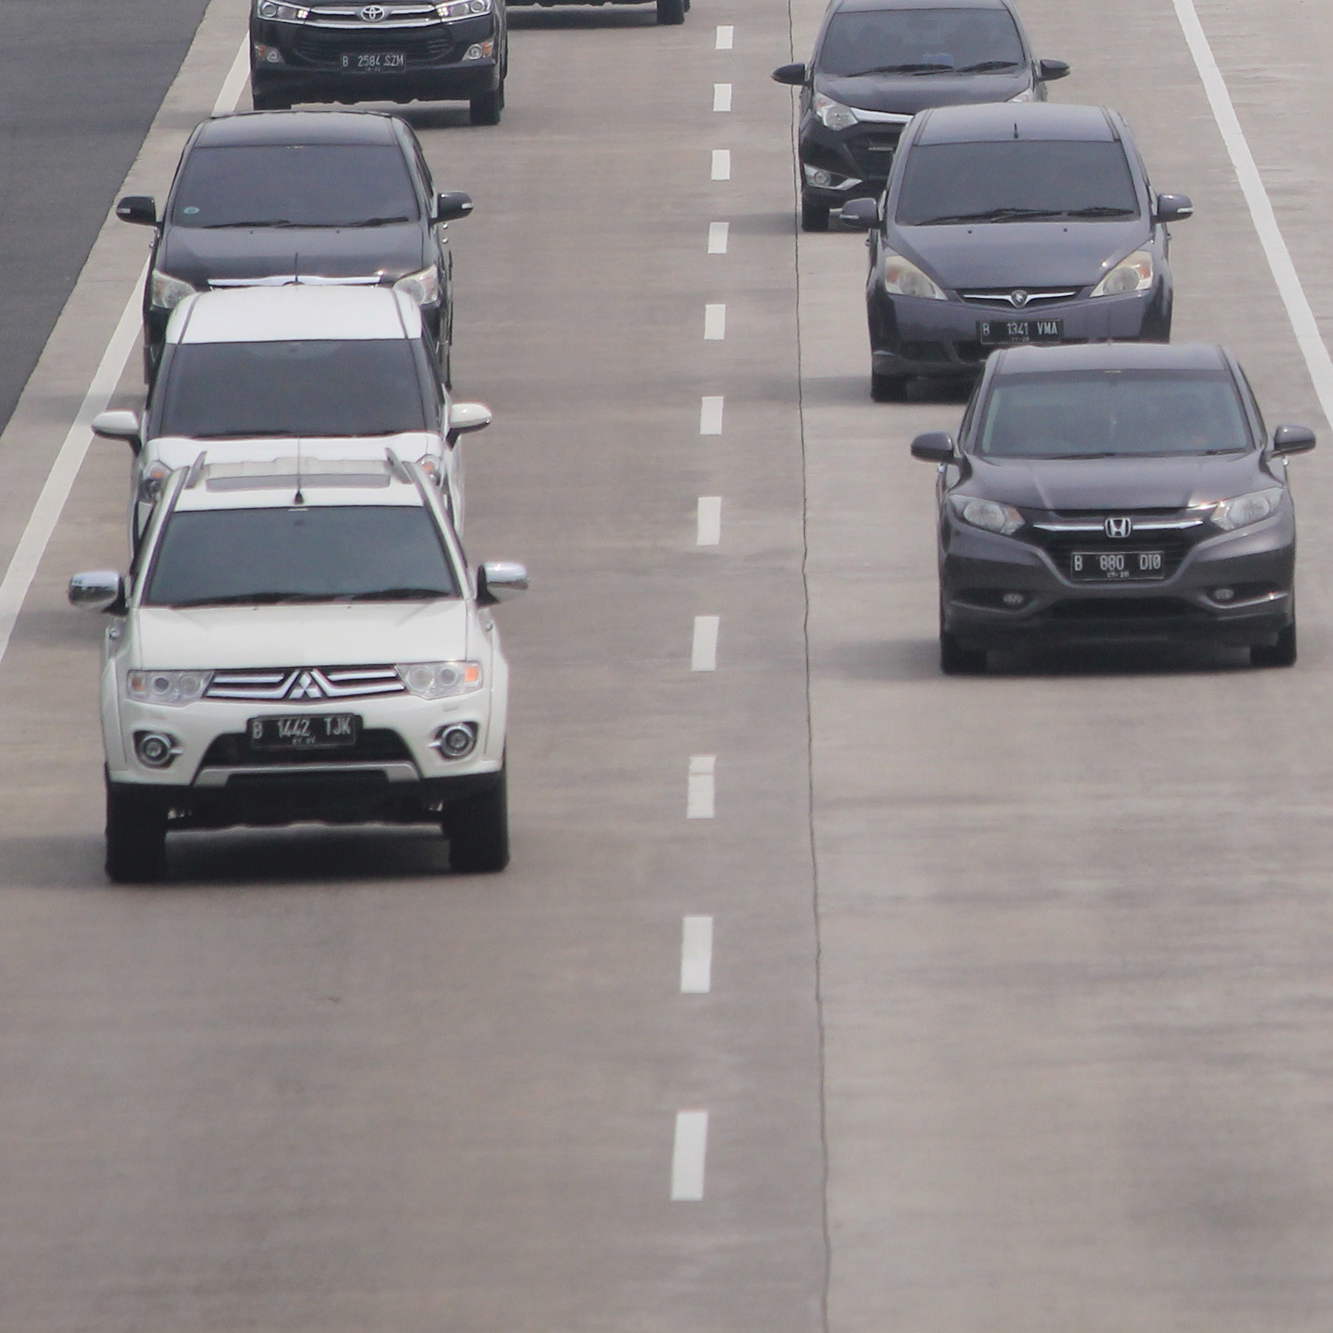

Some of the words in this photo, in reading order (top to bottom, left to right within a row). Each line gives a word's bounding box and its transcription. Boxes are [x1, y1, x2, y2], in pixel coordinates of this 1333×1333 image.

[342, 55, 349, 67] B
[358, 54, 381, 67] 2584
[982, 322, 991, 336] B
[1006, 322, 1029, 336] 1341
[1037, 322, 1058, 335] VMA
[1074, 555, 1084, 572] B
[1100, 555, 1124, 571] 880
[252, 721, 264, 739] B
[277, 719, 311, 738] 1442
[324, 717, 352, 736] TJK
